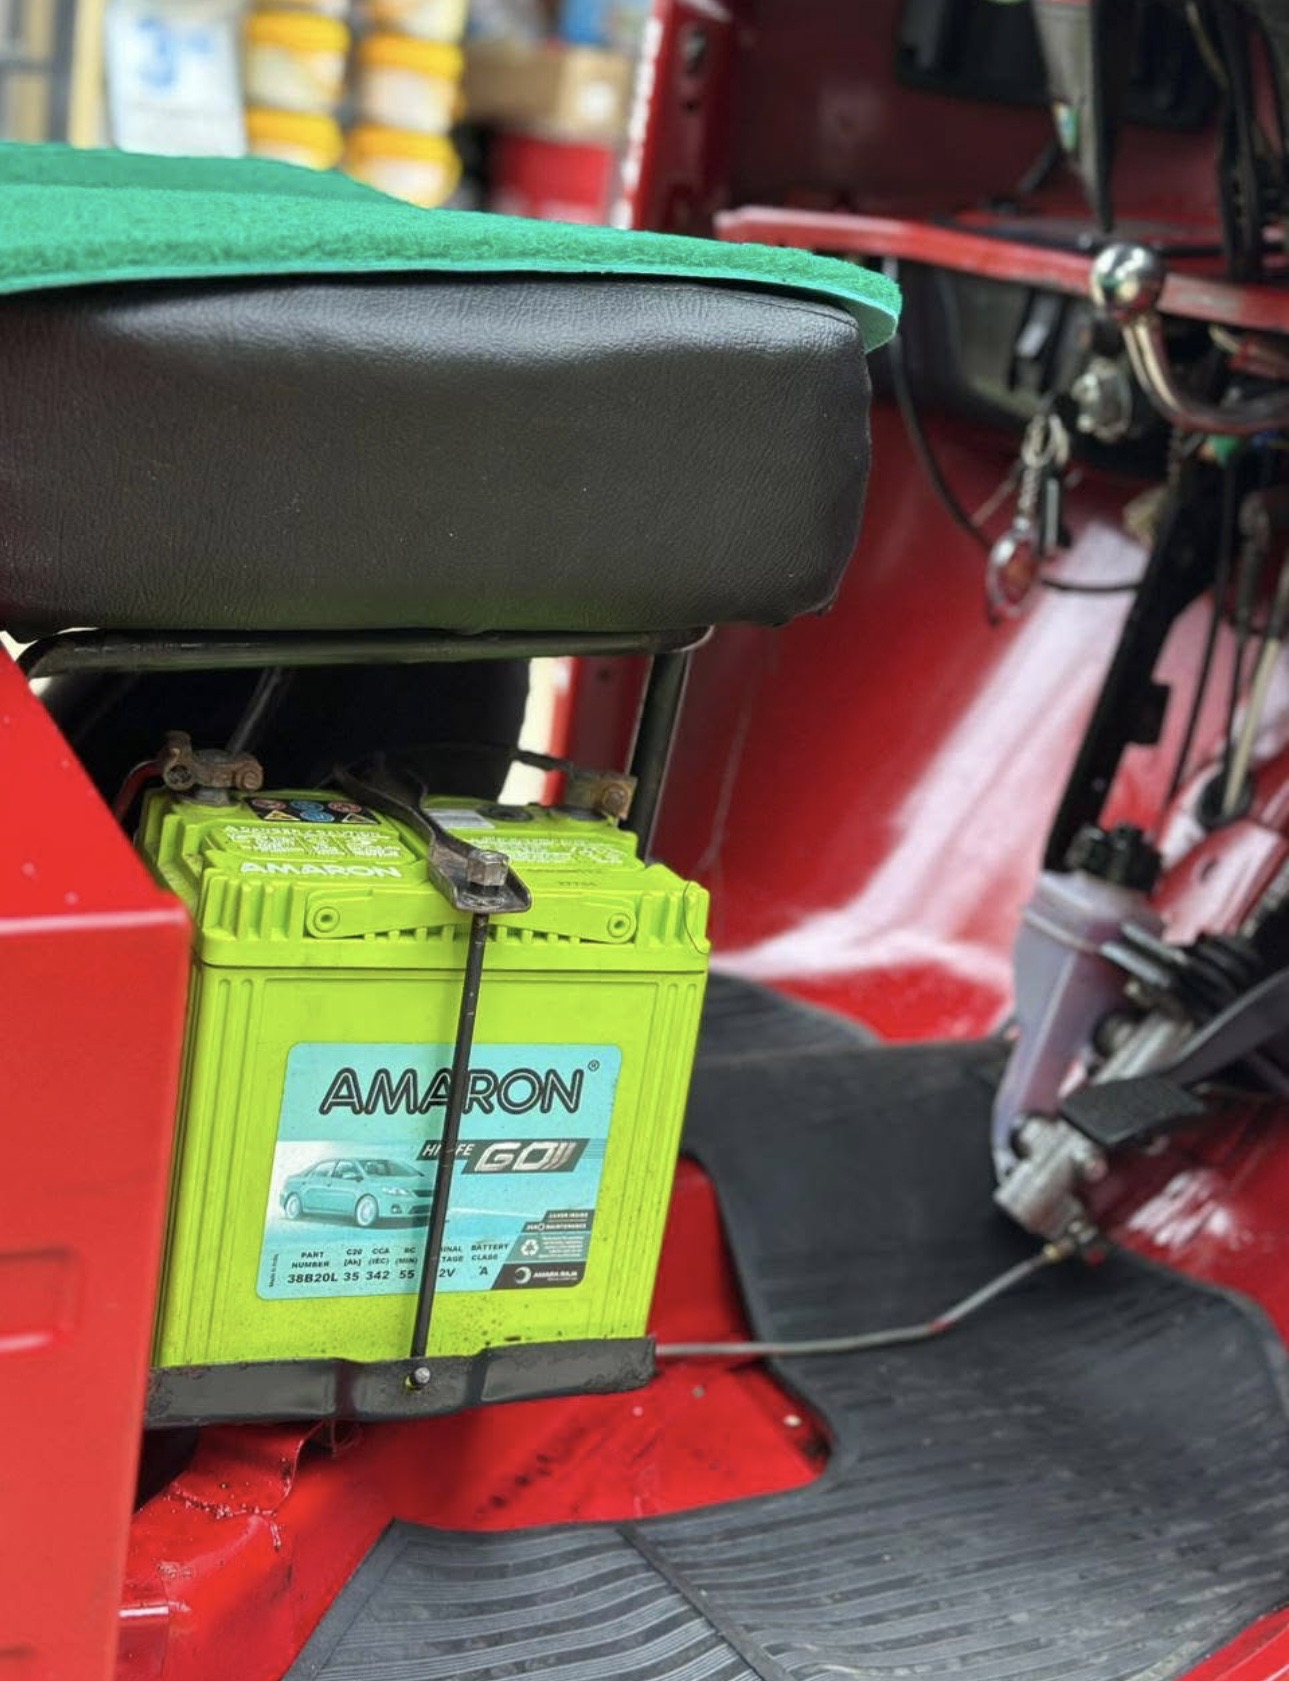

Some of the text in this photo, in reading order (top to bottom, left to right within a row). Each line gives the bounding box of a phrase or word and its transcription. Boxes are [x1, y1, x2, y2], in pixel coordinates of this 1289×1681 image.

[241, 862, 401, 878] AMARON
[319, 1067, 584, 1115] AMARON
[368, 1257, 389, 1265] (IEC)
[395, 1257, 418, 1265] (MIN)
[472, 1253, 498, 1261] CLASS
[287, 1272, 338, 1284] 38B20L
[343, 1271, 360, 1281] 35
[366, 1270, 390, 1280] 342
[398, 1269, 415, 1279] 55
[438, 1268, 456, 1277] 2V
